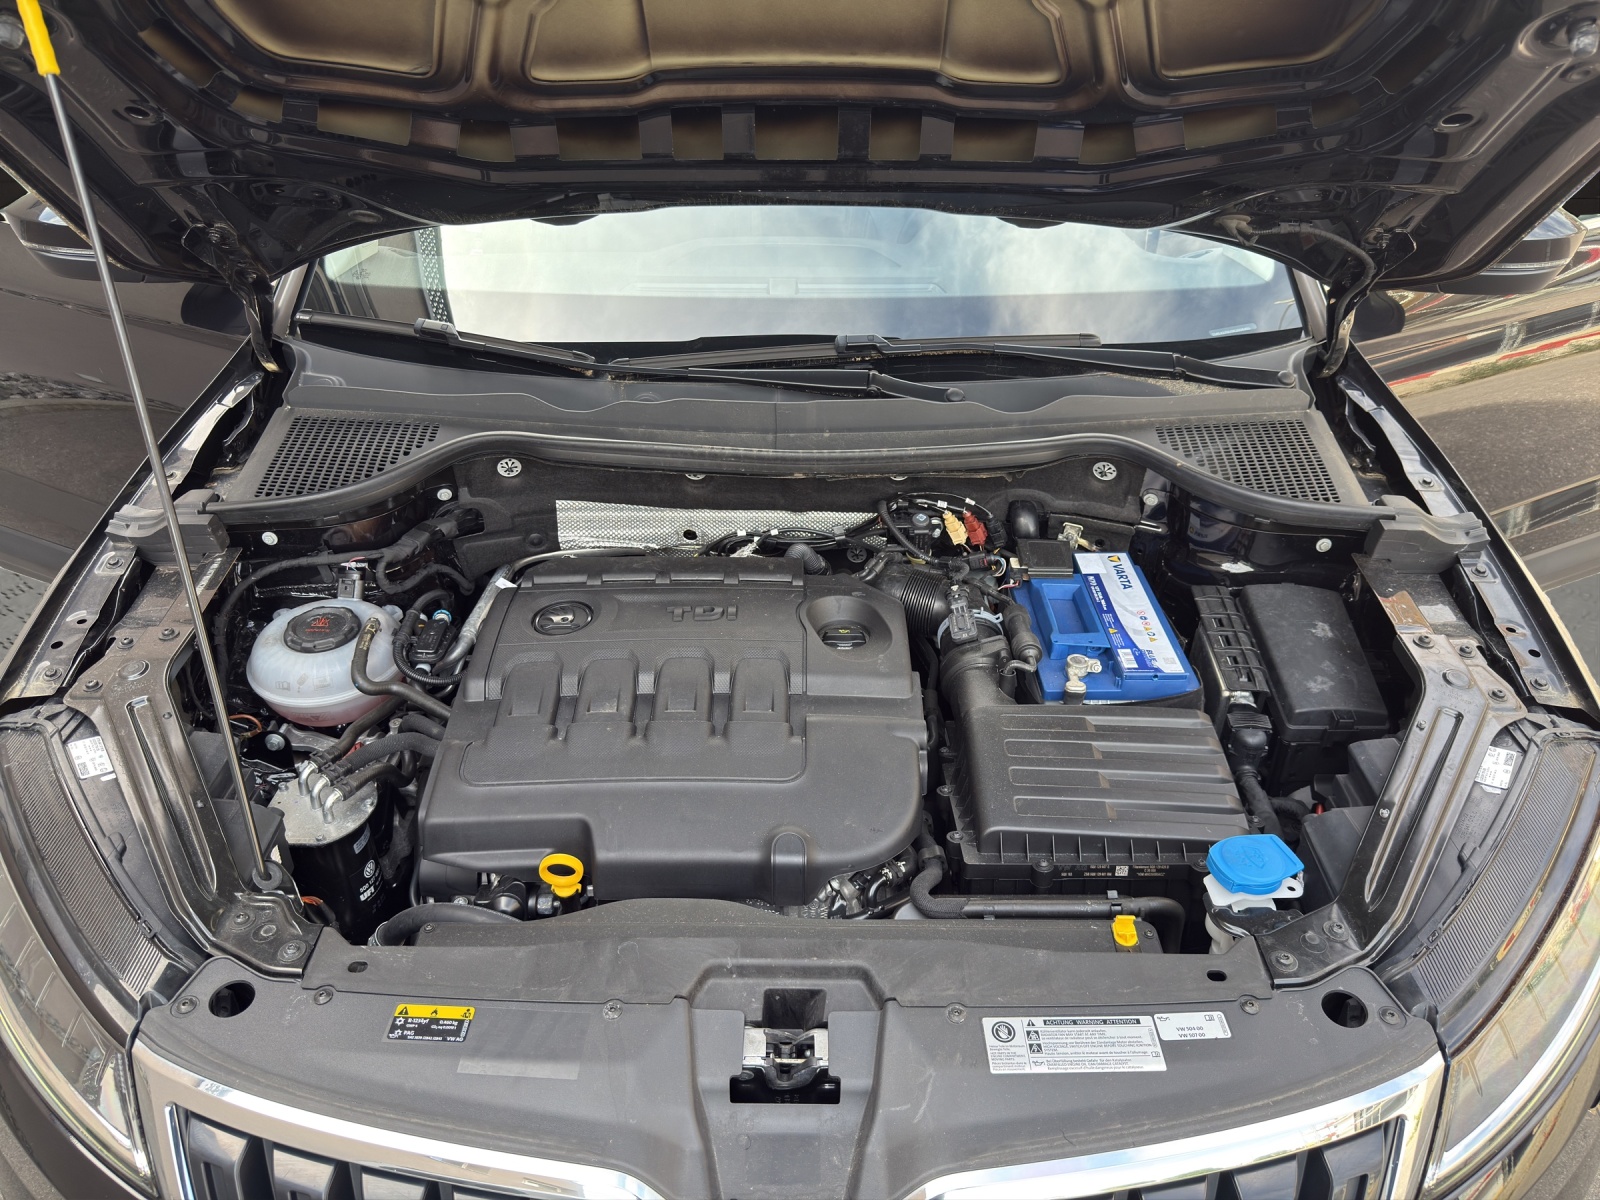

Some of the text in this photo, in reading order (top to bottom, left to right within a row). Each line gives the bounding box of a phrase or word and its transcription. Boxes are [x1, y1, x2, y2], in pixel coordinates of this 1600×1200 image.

[1113, 564, 1133, 590] VARTA
[666, 605, 737, 622] TDI
[360, 886, 375, 901] UFI
